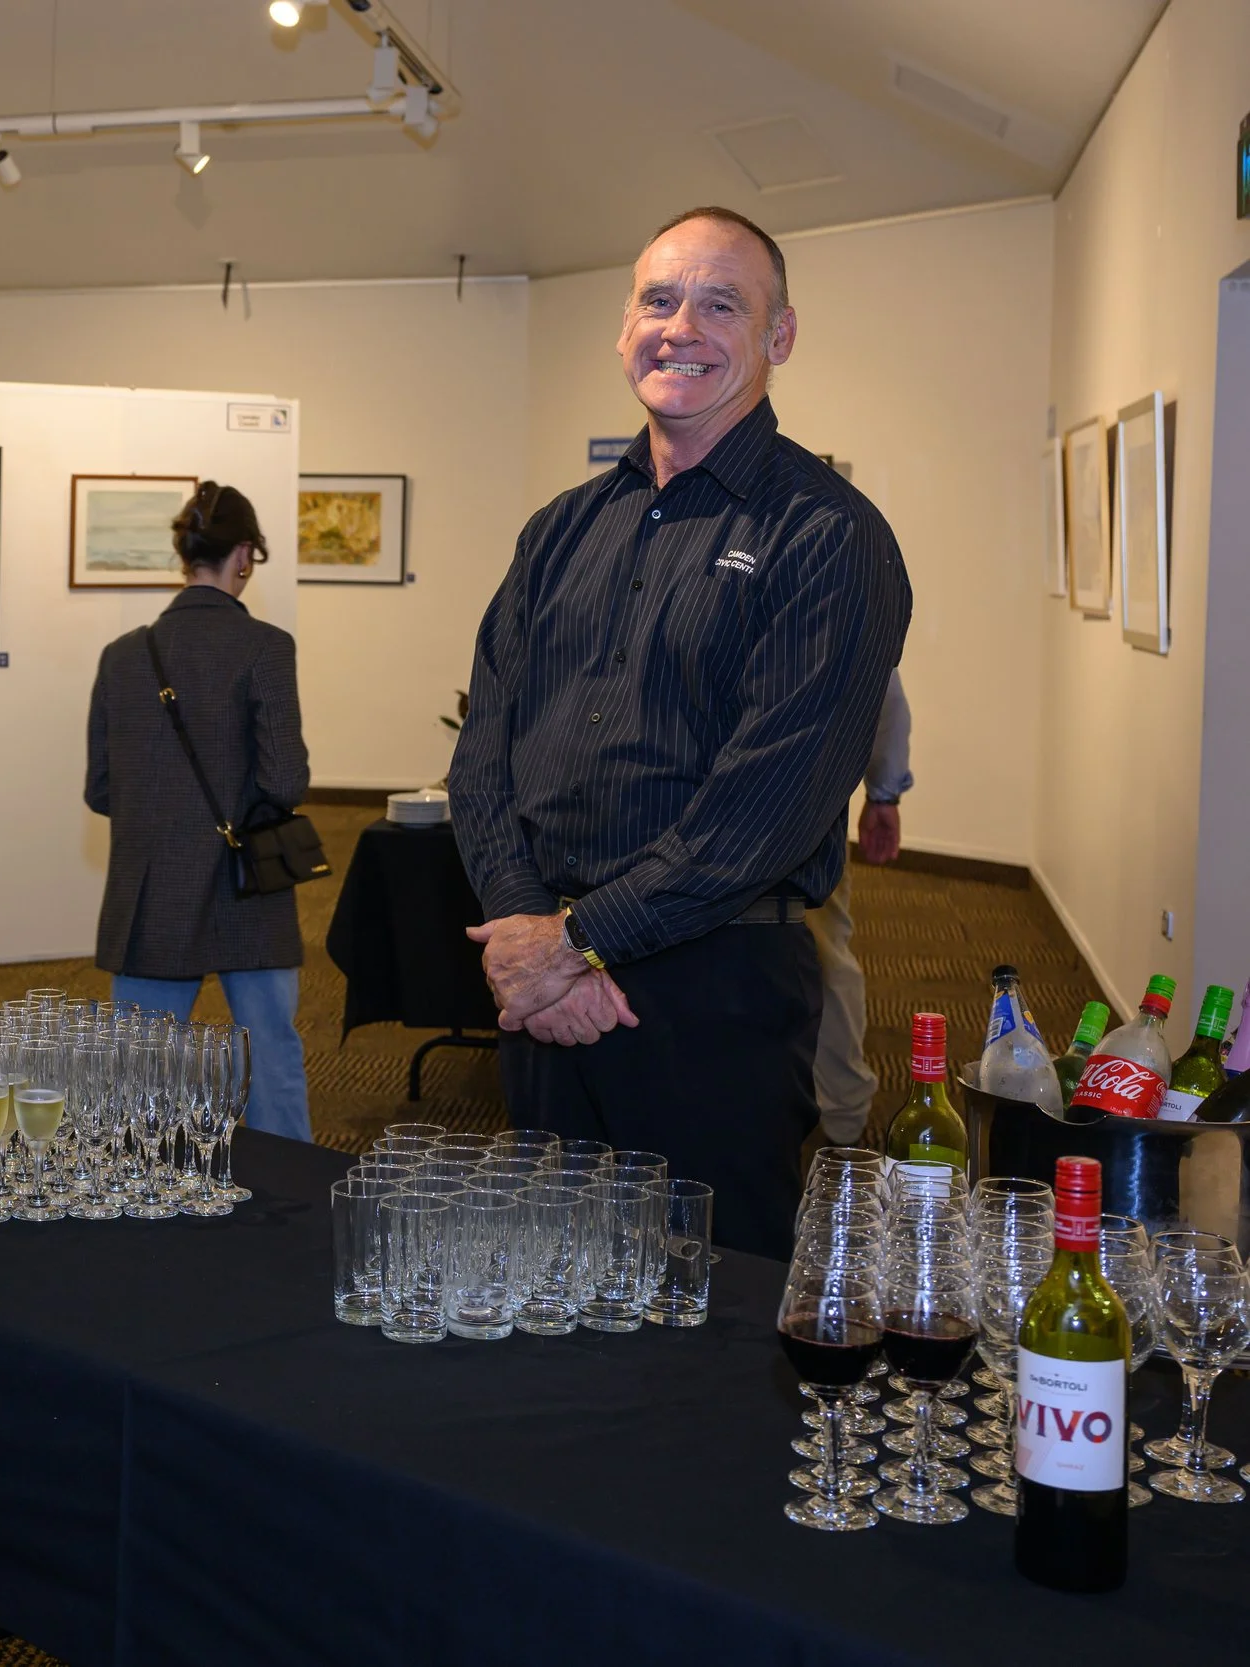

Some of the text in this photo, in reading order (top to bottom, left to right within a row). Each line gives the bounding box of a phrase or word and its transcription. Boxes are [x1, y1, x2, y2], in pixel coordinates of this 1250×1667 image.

[727, 550, 756, 565] CAMDEN
[714, 558, 731, 568] CIVIC
[1075, 1091, 1102, 1099] LASSIC
[1162, 1101, 1182, 1111] RTOLI
[1014, 1393, 1113, 1444] VIVO
